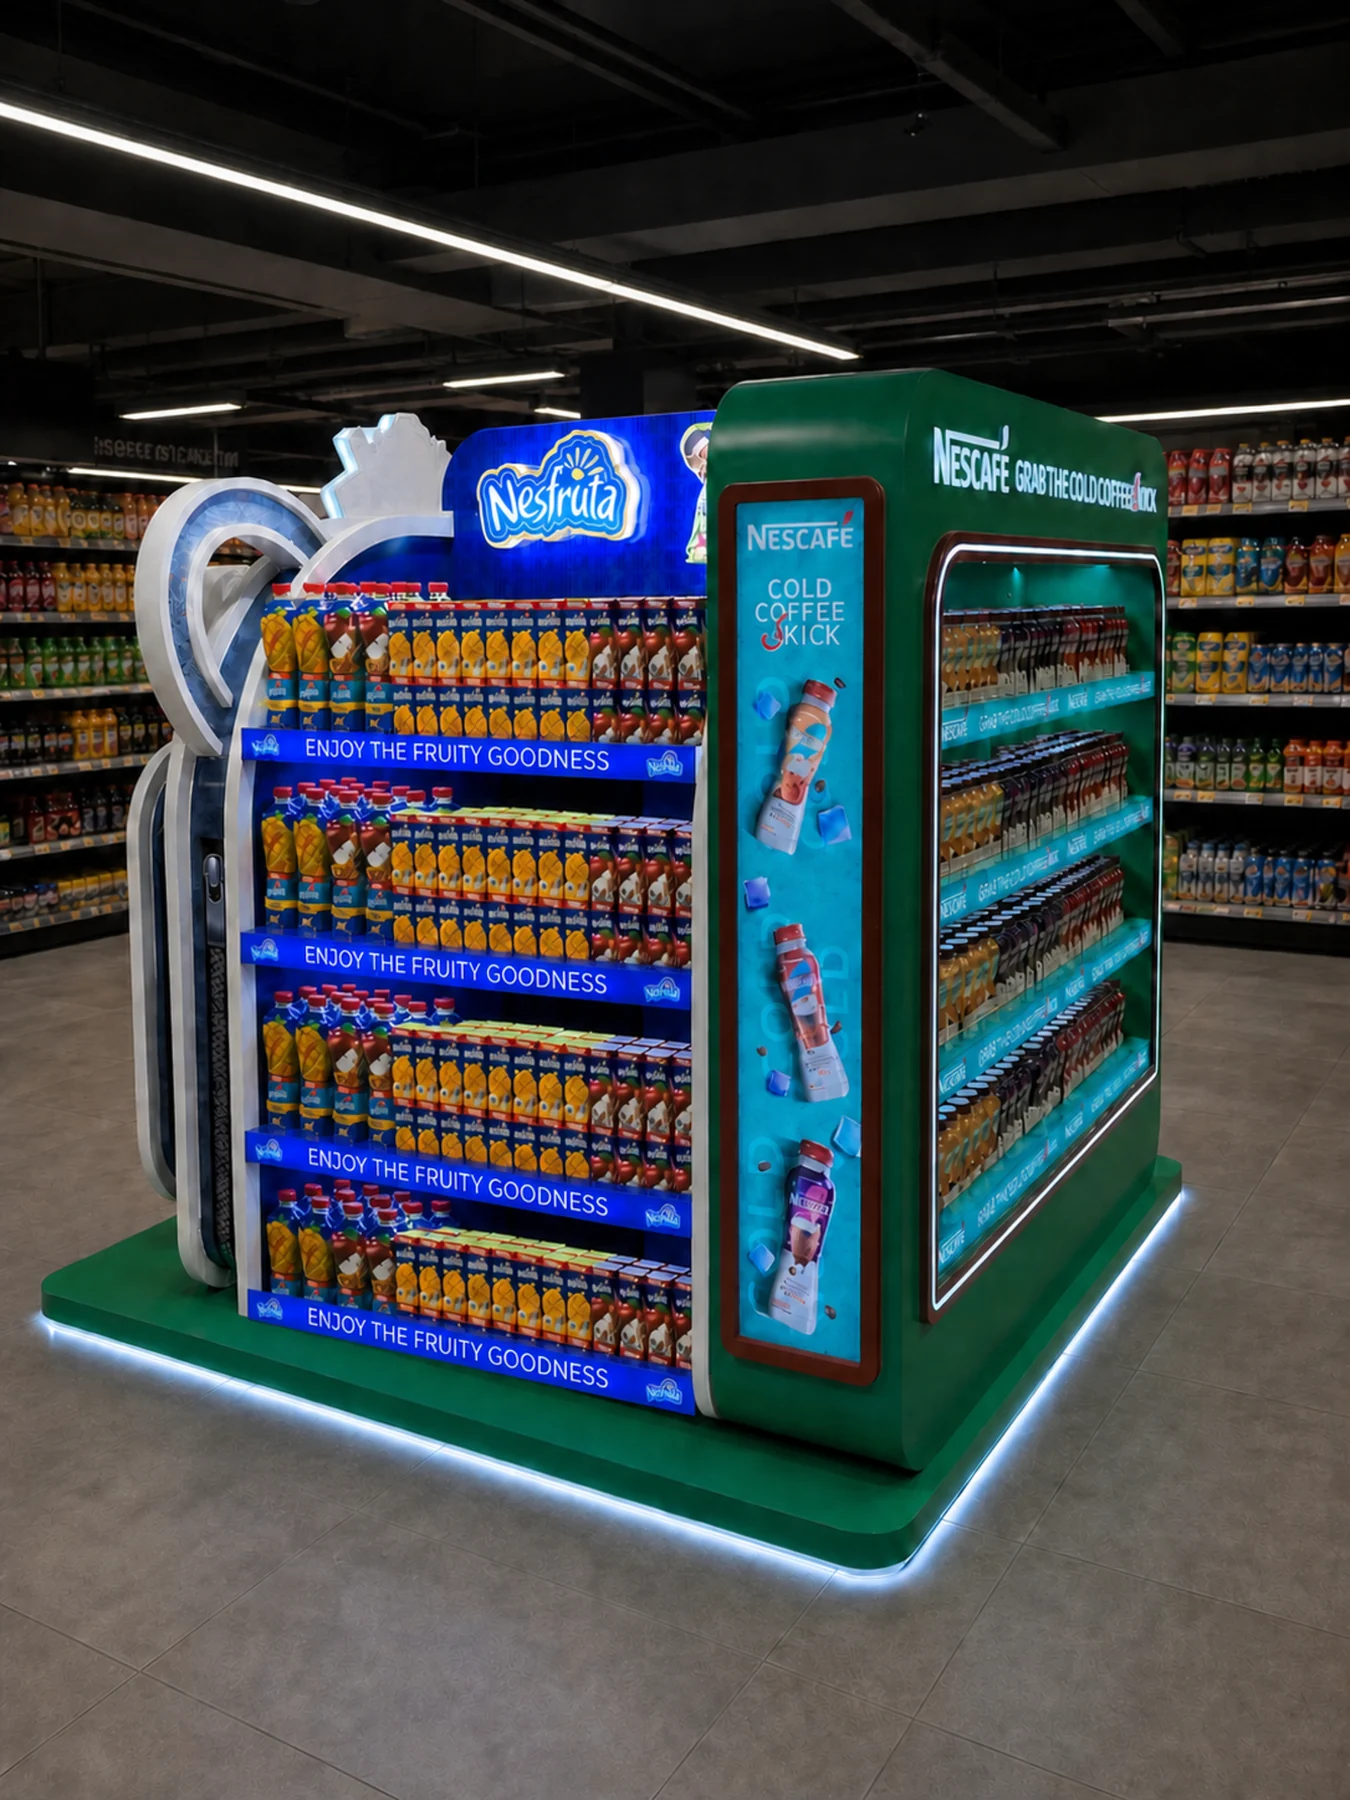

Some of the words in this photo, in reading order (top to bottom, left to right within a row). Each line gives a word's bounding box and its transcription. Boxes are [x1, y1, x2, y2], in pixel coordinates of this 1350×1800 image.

[933, 425, 1010, 494] NESCAFÉ
[1015, 459, 1046, 496] GRAB
[1046, 465, 1069, 499] THE
[1069, 470, 1097, 504] COLD
[488, 465, 617, 532] Nesfruta
[747, 511, 854, 551] NESCAFÉ
[768, 578, 832, 599] COLD
[755, 602, 845, 622] COFFEE
[785, 624, 840, 645] KICK
[306, 739, 364, 759] ENJOY
[370, 741, 406, 760] THE
[414, 743, 482, 764] FRUITY
[488, 746, 609, 771] GOODNESS
[306, 946, 364, 968] ENJOY
[369, 952, 406, 974] THE
[412, 957, 481, 981] FRUITY
[487, 964, 607, 994] GOODNESS
[309, 1148, 367, 1174] ENJOY
[373, 1158, 409, 1181] THE
[415, 1166, 482, 1194] FRUITY
[488, 1178, 608, 1216] GOODNESS
[308, 1307, 366, 1336] ENJOY
[372, 1321, 407, 1346] THE
[414, 1330, 482, 1361] FRUITY
[488, 1345, 609, 1388] GOODNESS
